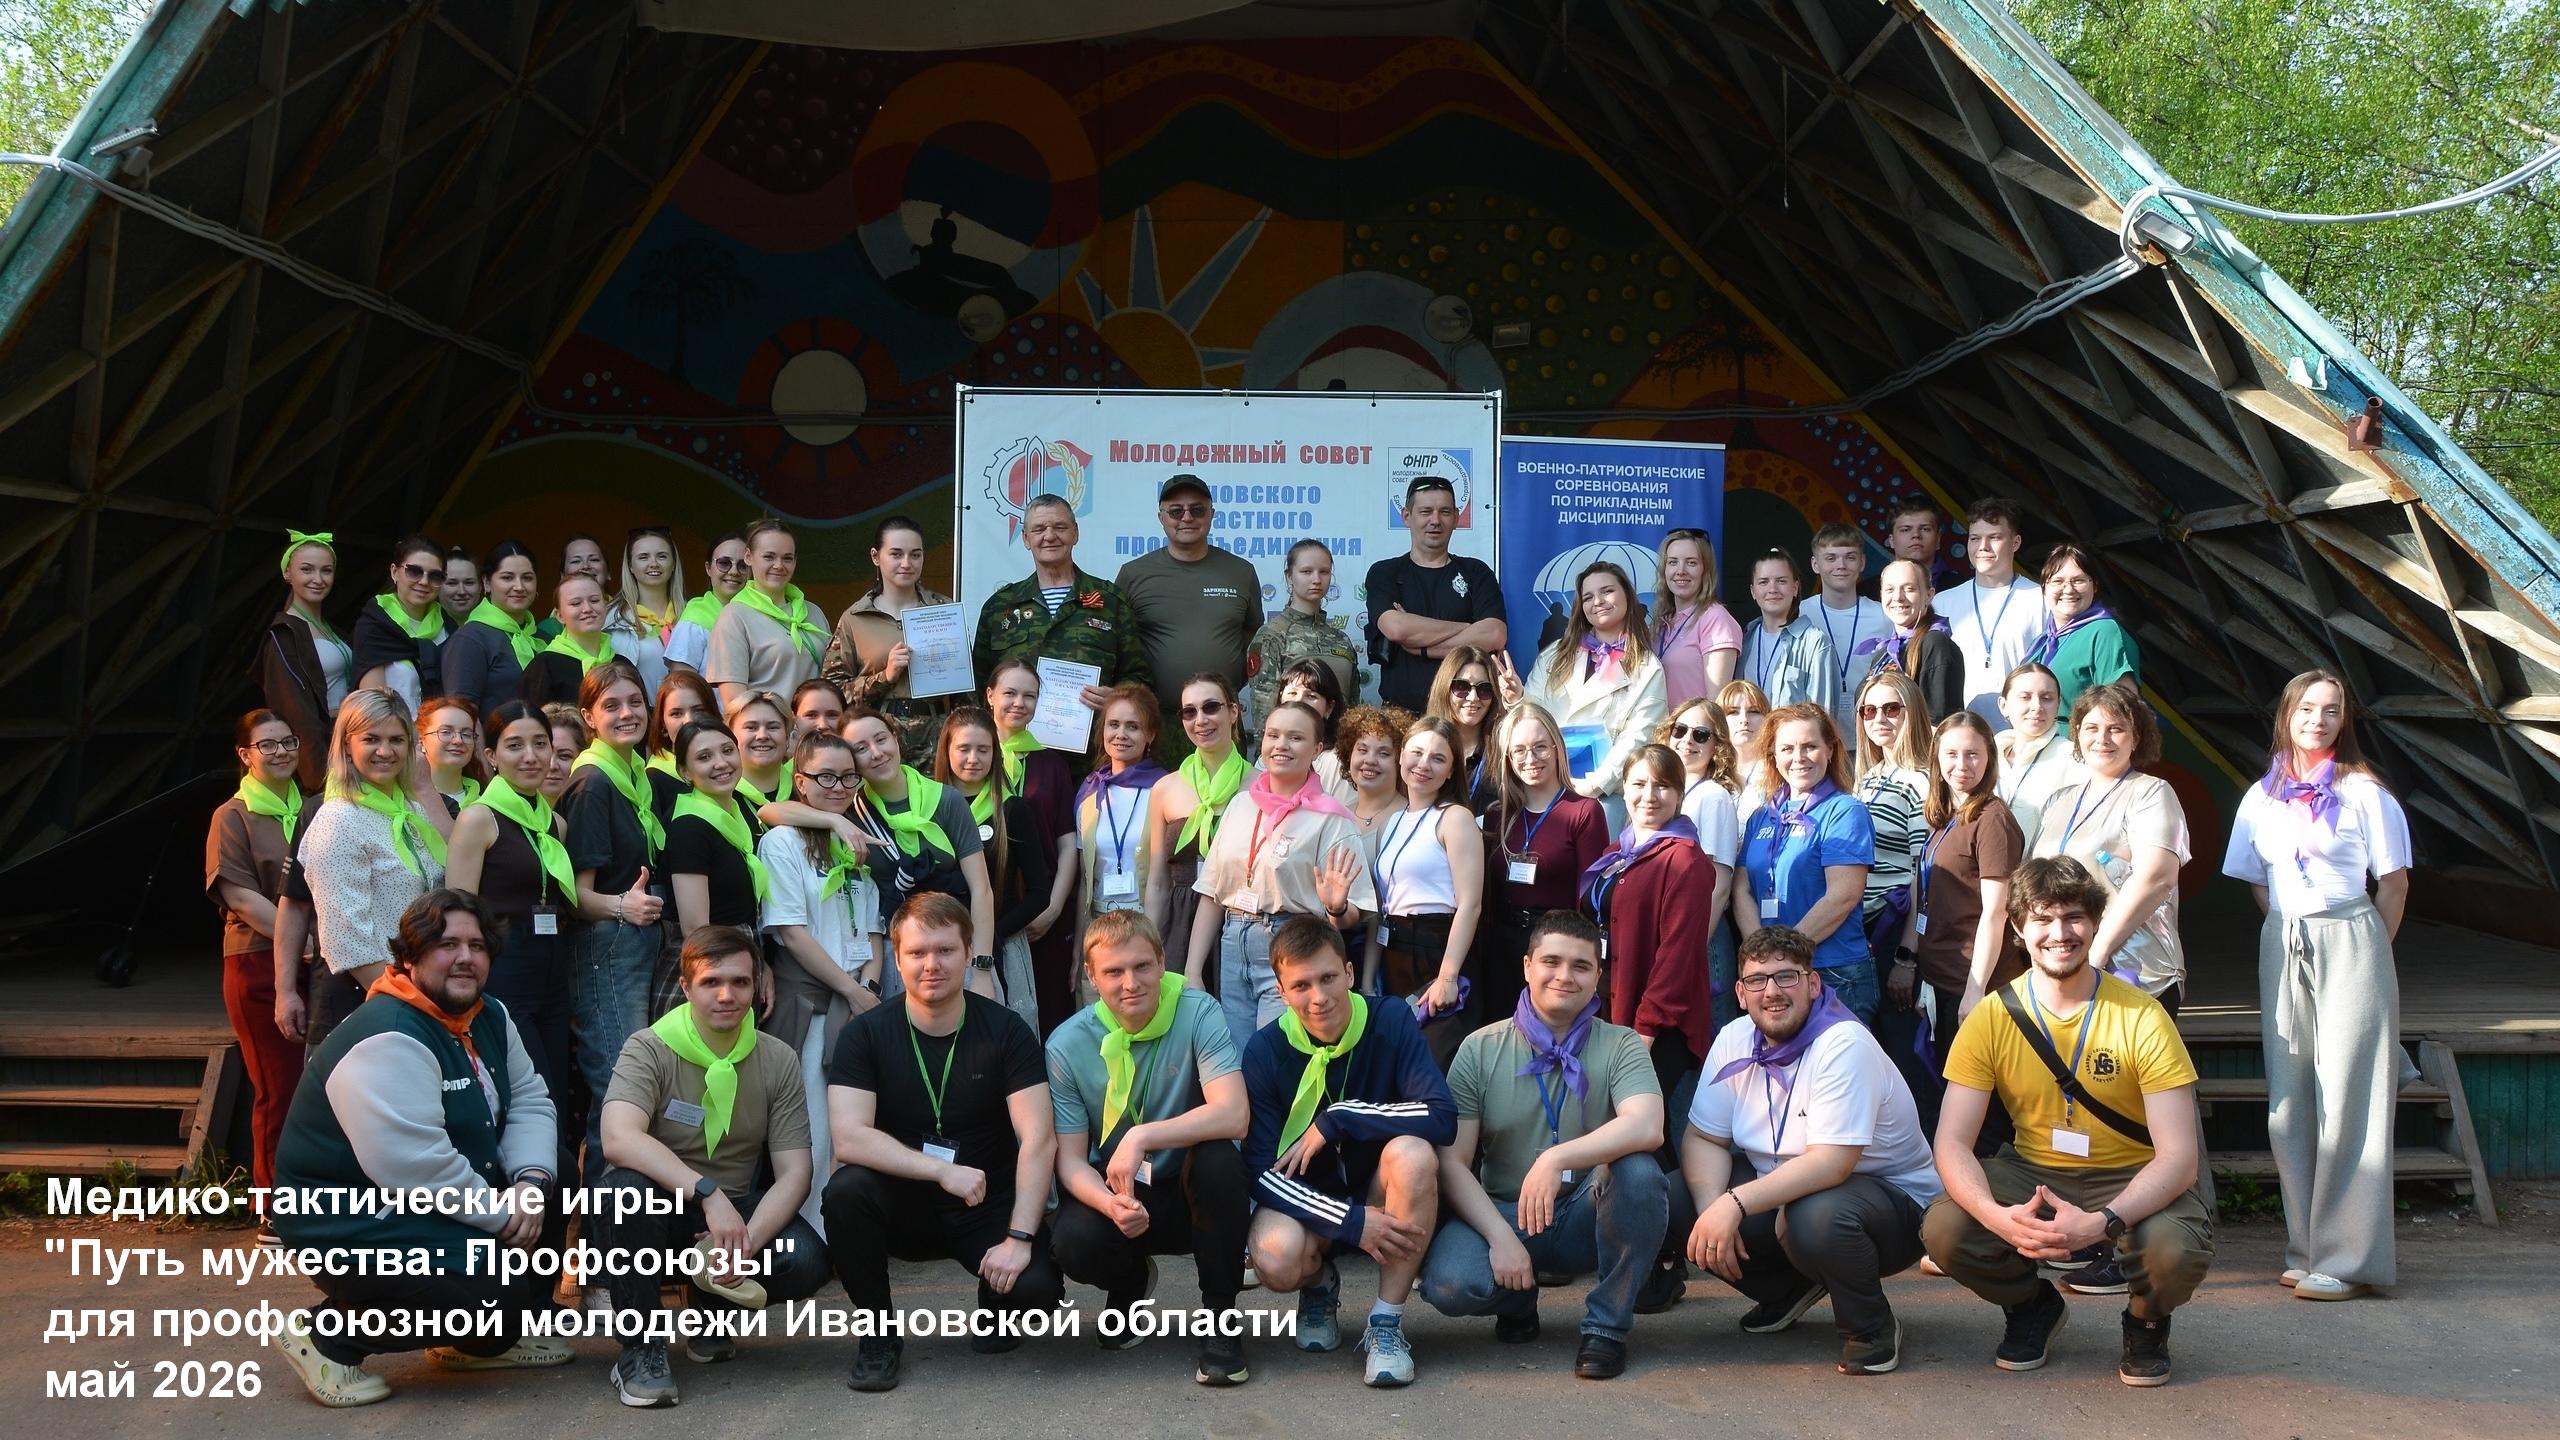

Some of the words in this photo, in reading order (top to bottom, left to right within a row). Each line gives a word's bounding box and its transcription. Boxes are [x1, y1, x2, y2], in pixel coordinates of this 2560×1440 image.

[1109, 439, 1287, 466] Молодежный
[1299, 444, 1373, 465] совет
[1402, 454, 1439, 468] ФНПР
[1517, 461, 1706, 480] ВОЕННО-ПАТРИОТИЧЕСКИЕ
[1157, 481, 1322, 505] новского
[1554, 479, 1669, 494] СОРЕВНОВАНИЯ
[1551, 495, 1571, 507] ПО
[1574, 495, 1673, 511] ПРИКЛАДНЫМ
[1212, 510, 1313, 531] астного
[1557, 511, 1666, 526] ДИСЦИПЛИНАМ
